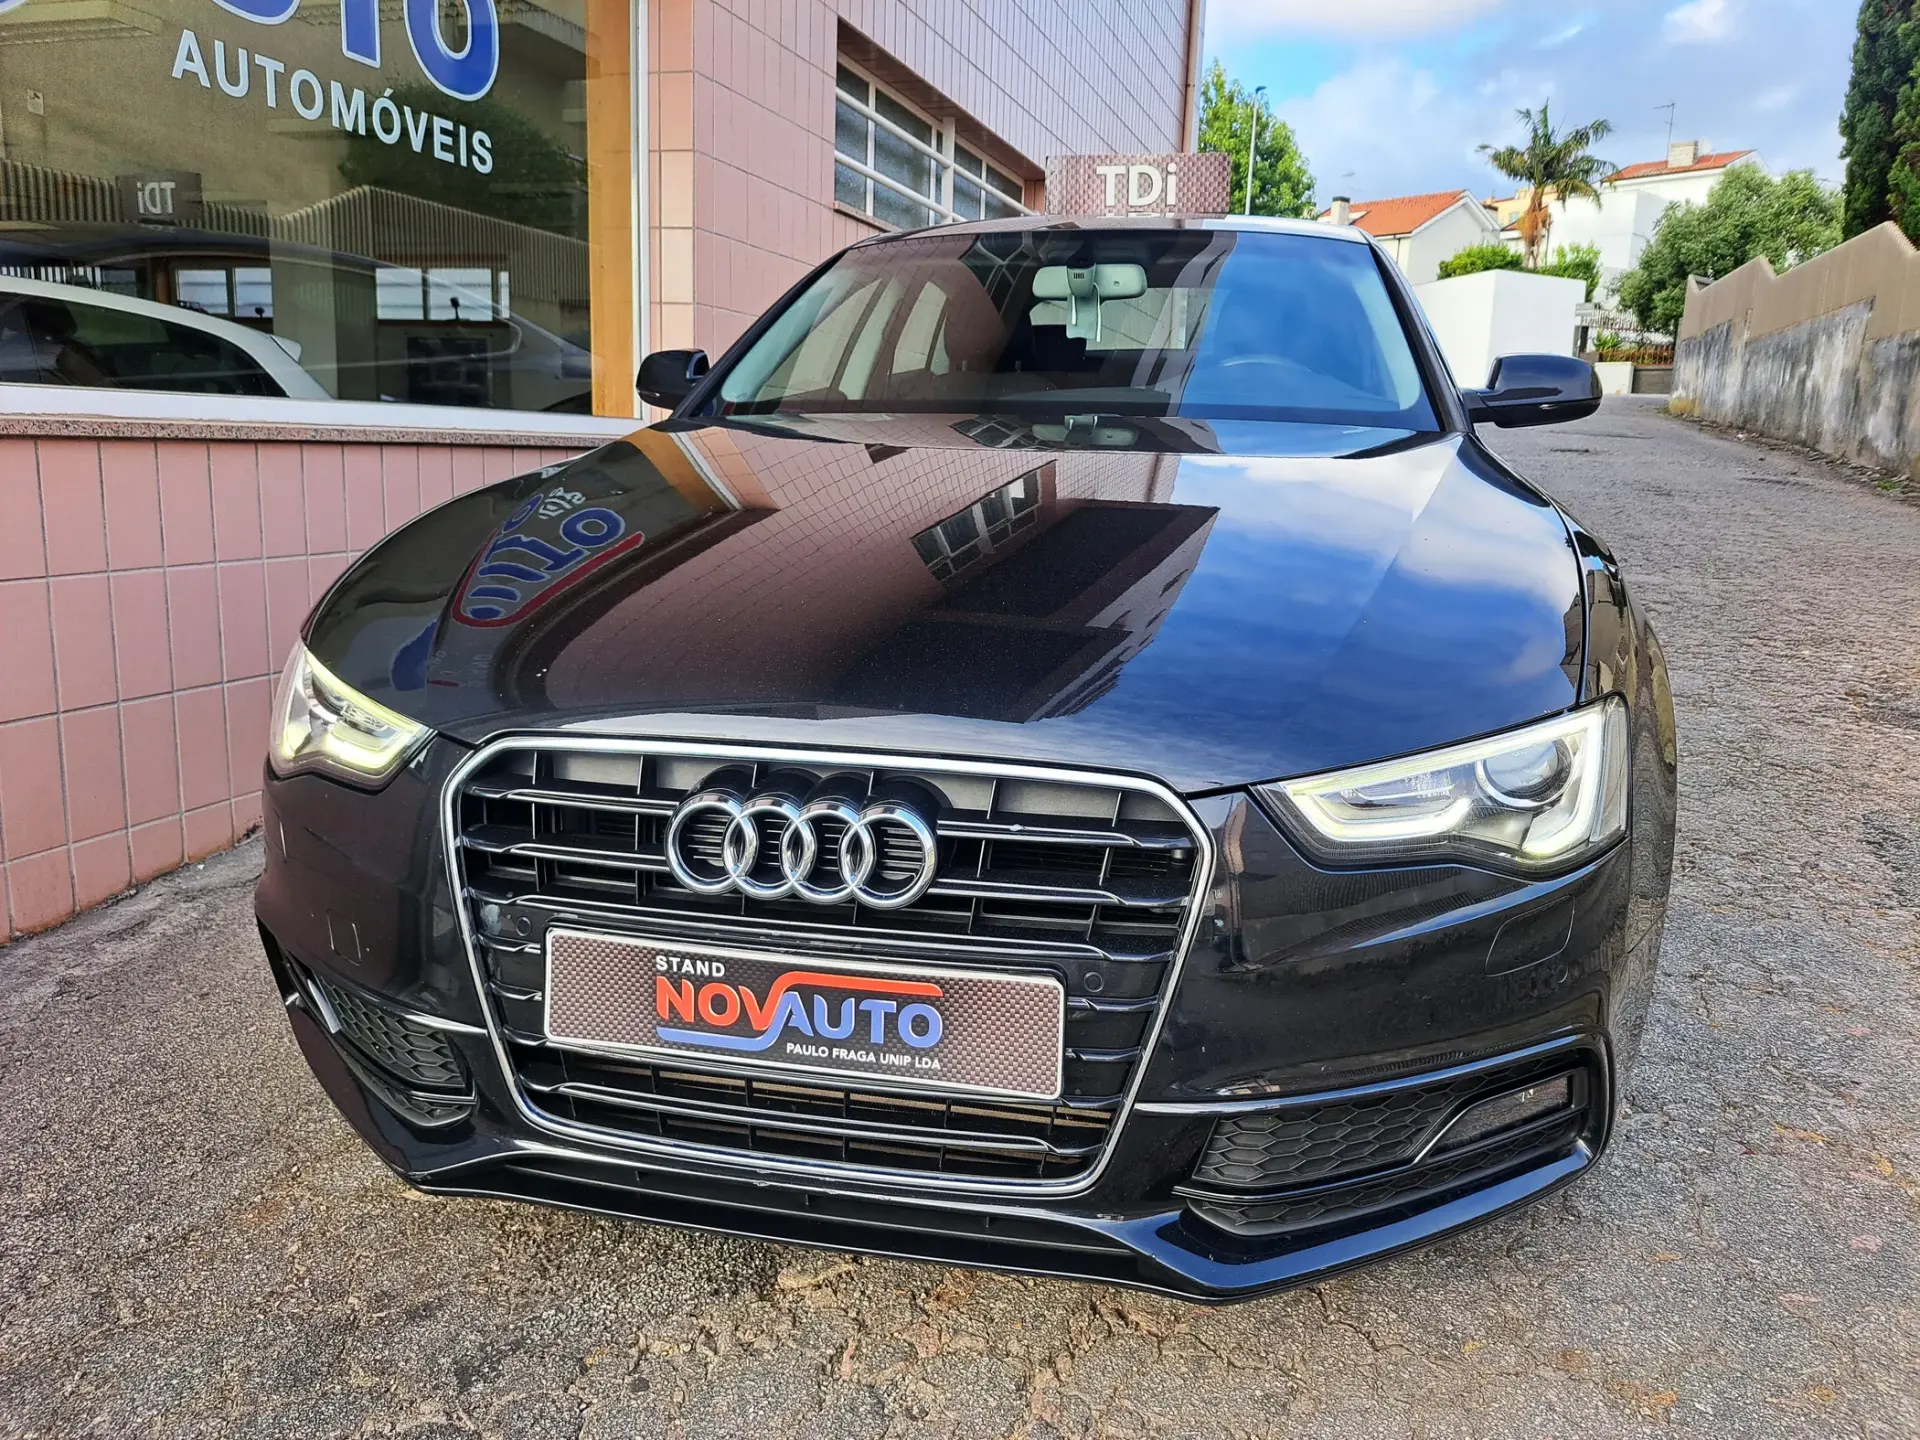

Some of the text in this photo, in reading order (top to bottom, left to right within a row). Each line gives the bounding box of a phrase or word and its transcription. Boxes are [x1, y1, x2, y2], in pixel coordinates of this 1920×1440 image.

[172, 29, 494, 175] AUTOMÓVEIS
[1096, 162, 1177, 207] TDi
[655, 955, 725, 978] STAND
[655, 973, 943, 1049] NOVAUTO
[786, 1042, 941, 1070] PAULO FRAGA UNIP LDA
